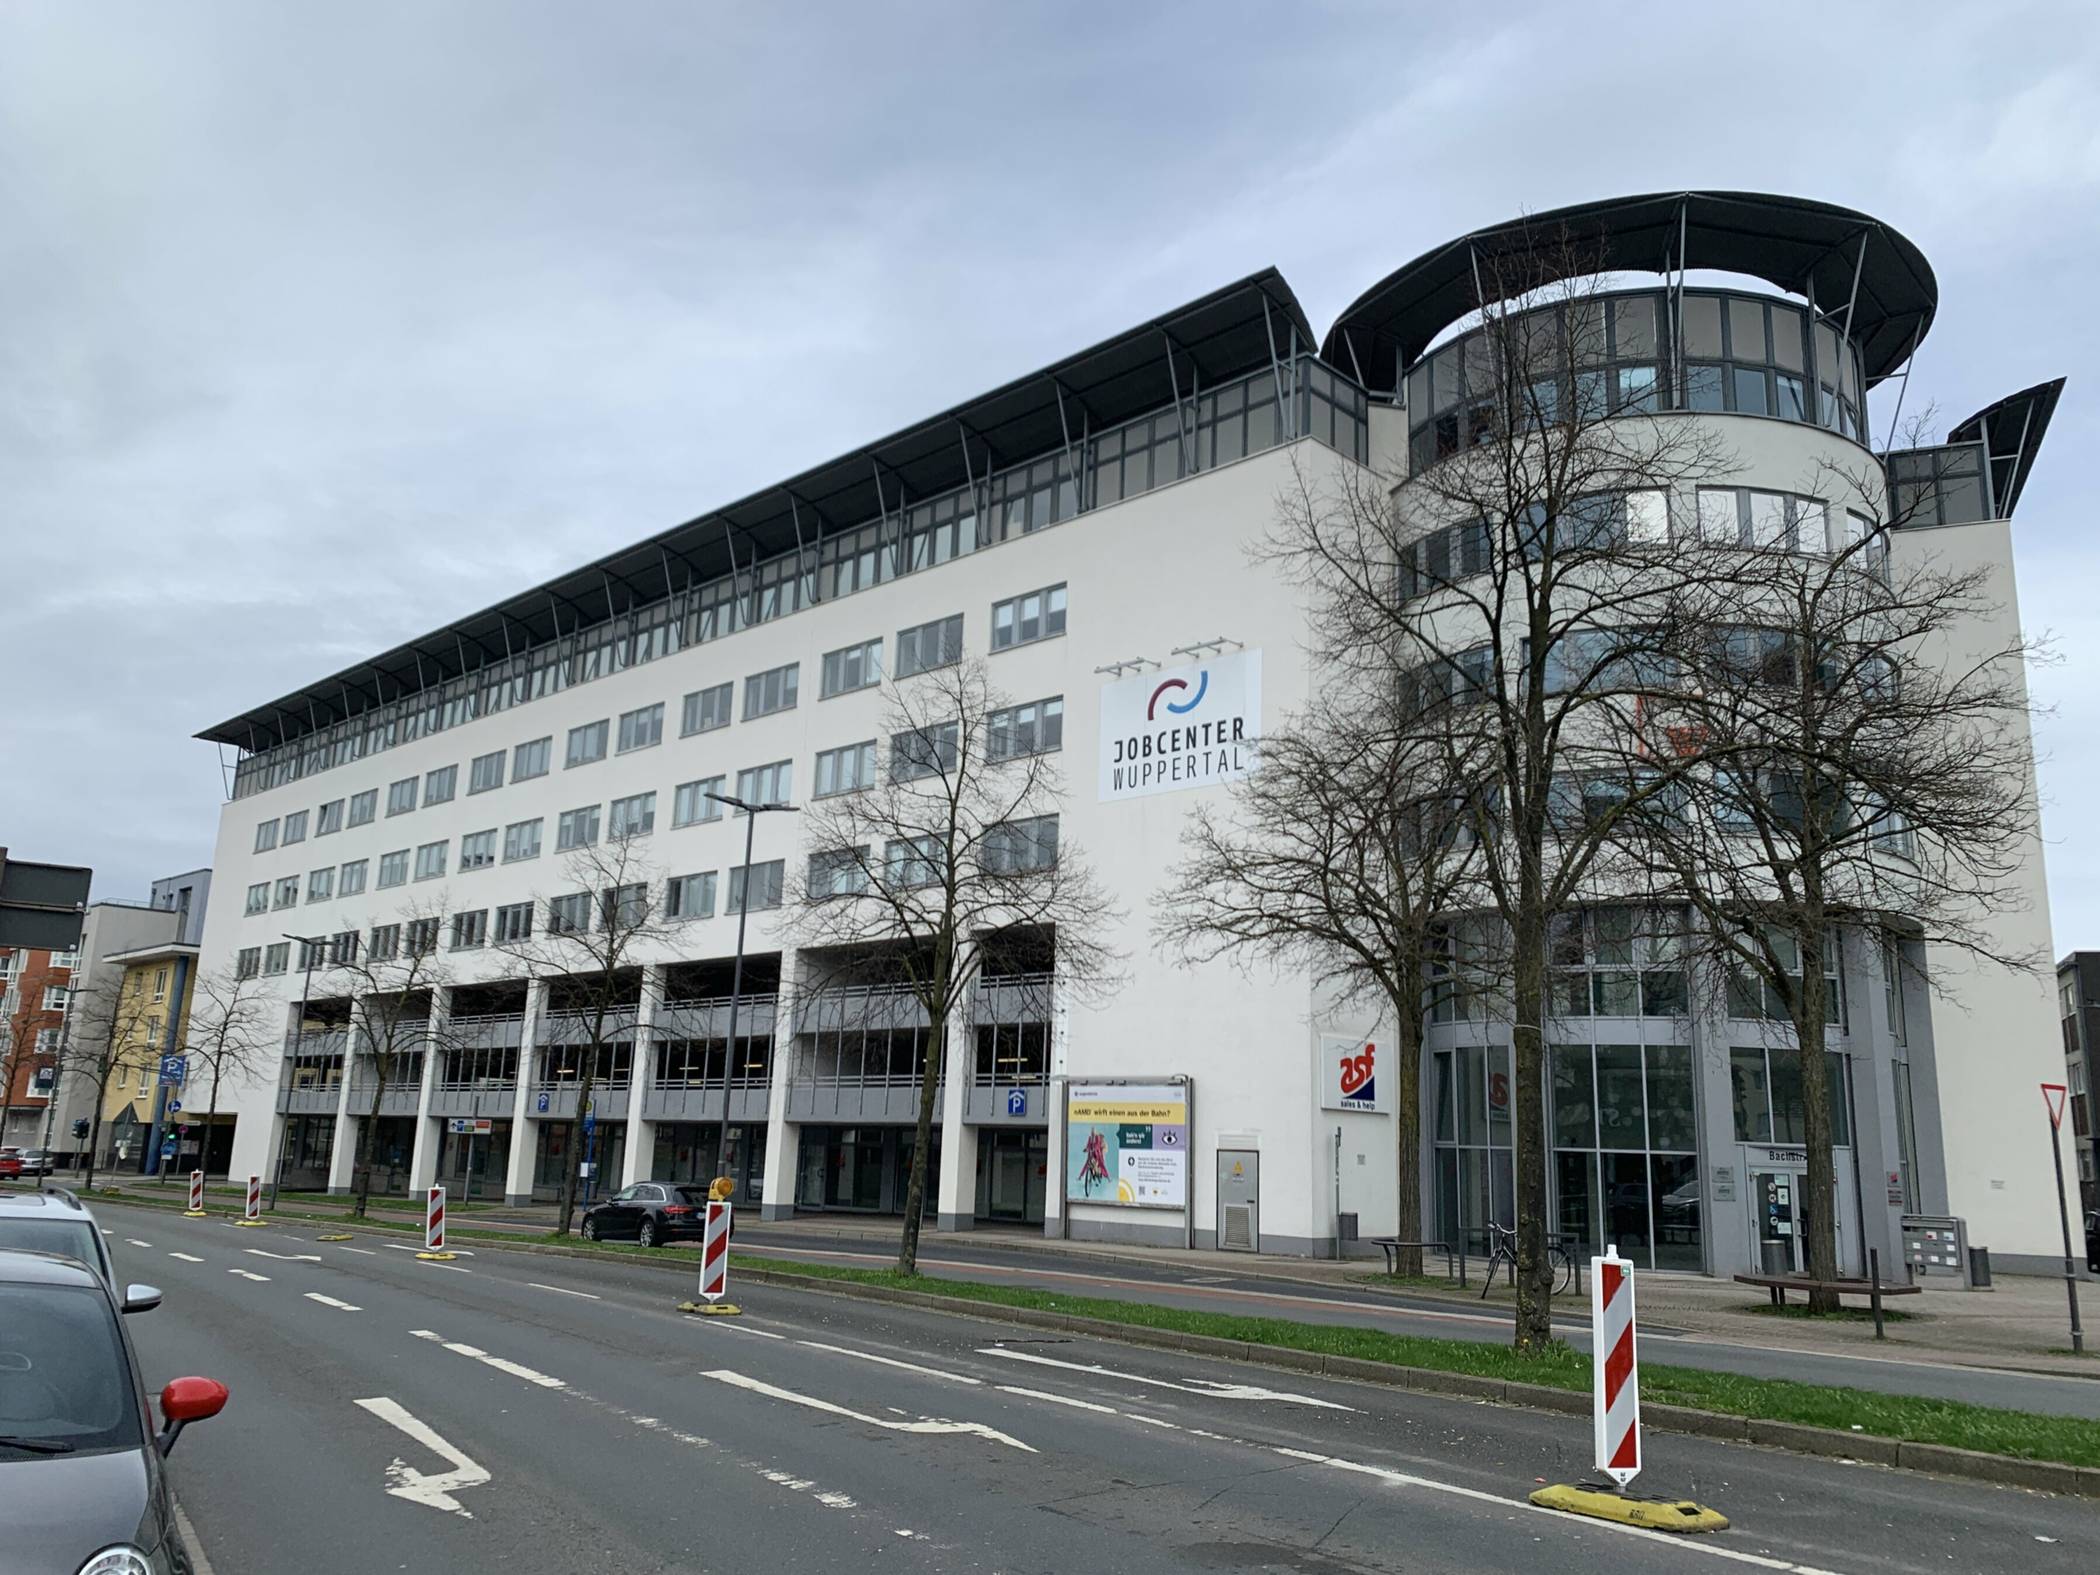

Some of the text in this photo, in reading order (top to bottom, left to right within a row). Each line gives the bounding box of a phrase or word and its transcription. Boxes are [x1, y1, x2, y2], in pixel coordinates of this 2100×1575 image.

[1113, 717, 1244, 763] JOBCENTER
[1113, 747, 1244, 791] WUPPERTAL
[1341, 1100, 1355, 1109] sales
[1362, 1101, 1376, 1112] help
[1769, 1151, 1807, 1161] Bachstr
